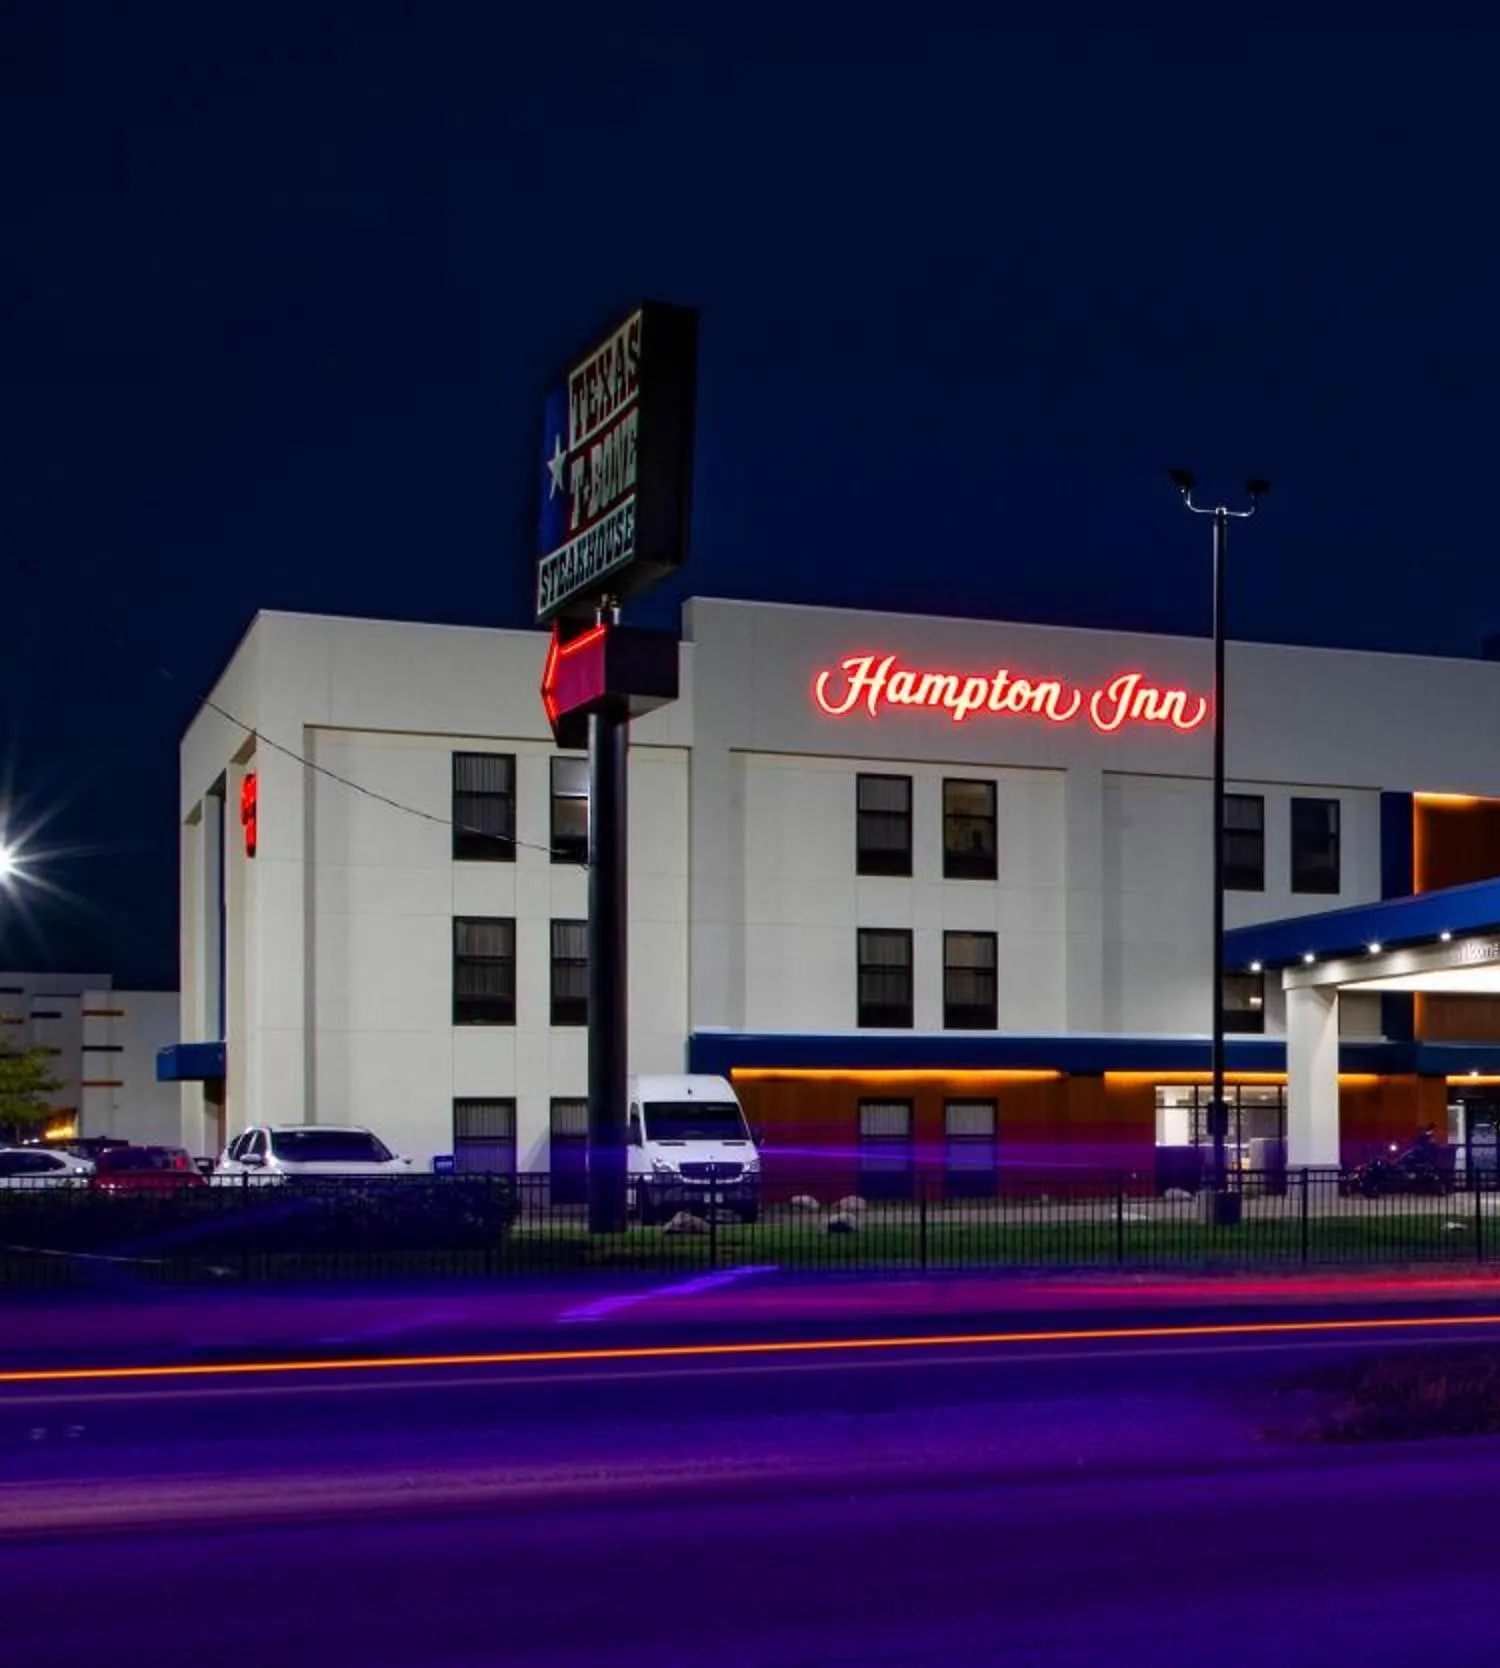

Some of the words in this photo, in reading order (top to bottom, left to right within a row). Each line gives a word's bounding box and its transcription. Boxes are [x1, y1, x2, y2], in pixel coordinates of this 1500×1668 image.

[572, 321, 639, 436] TEXAS
[541, 509, 633, 604] STEAKHOUSE
[815, 655, 1081, 721] Hampton
[1089, 672, 1208, 732] Inn
